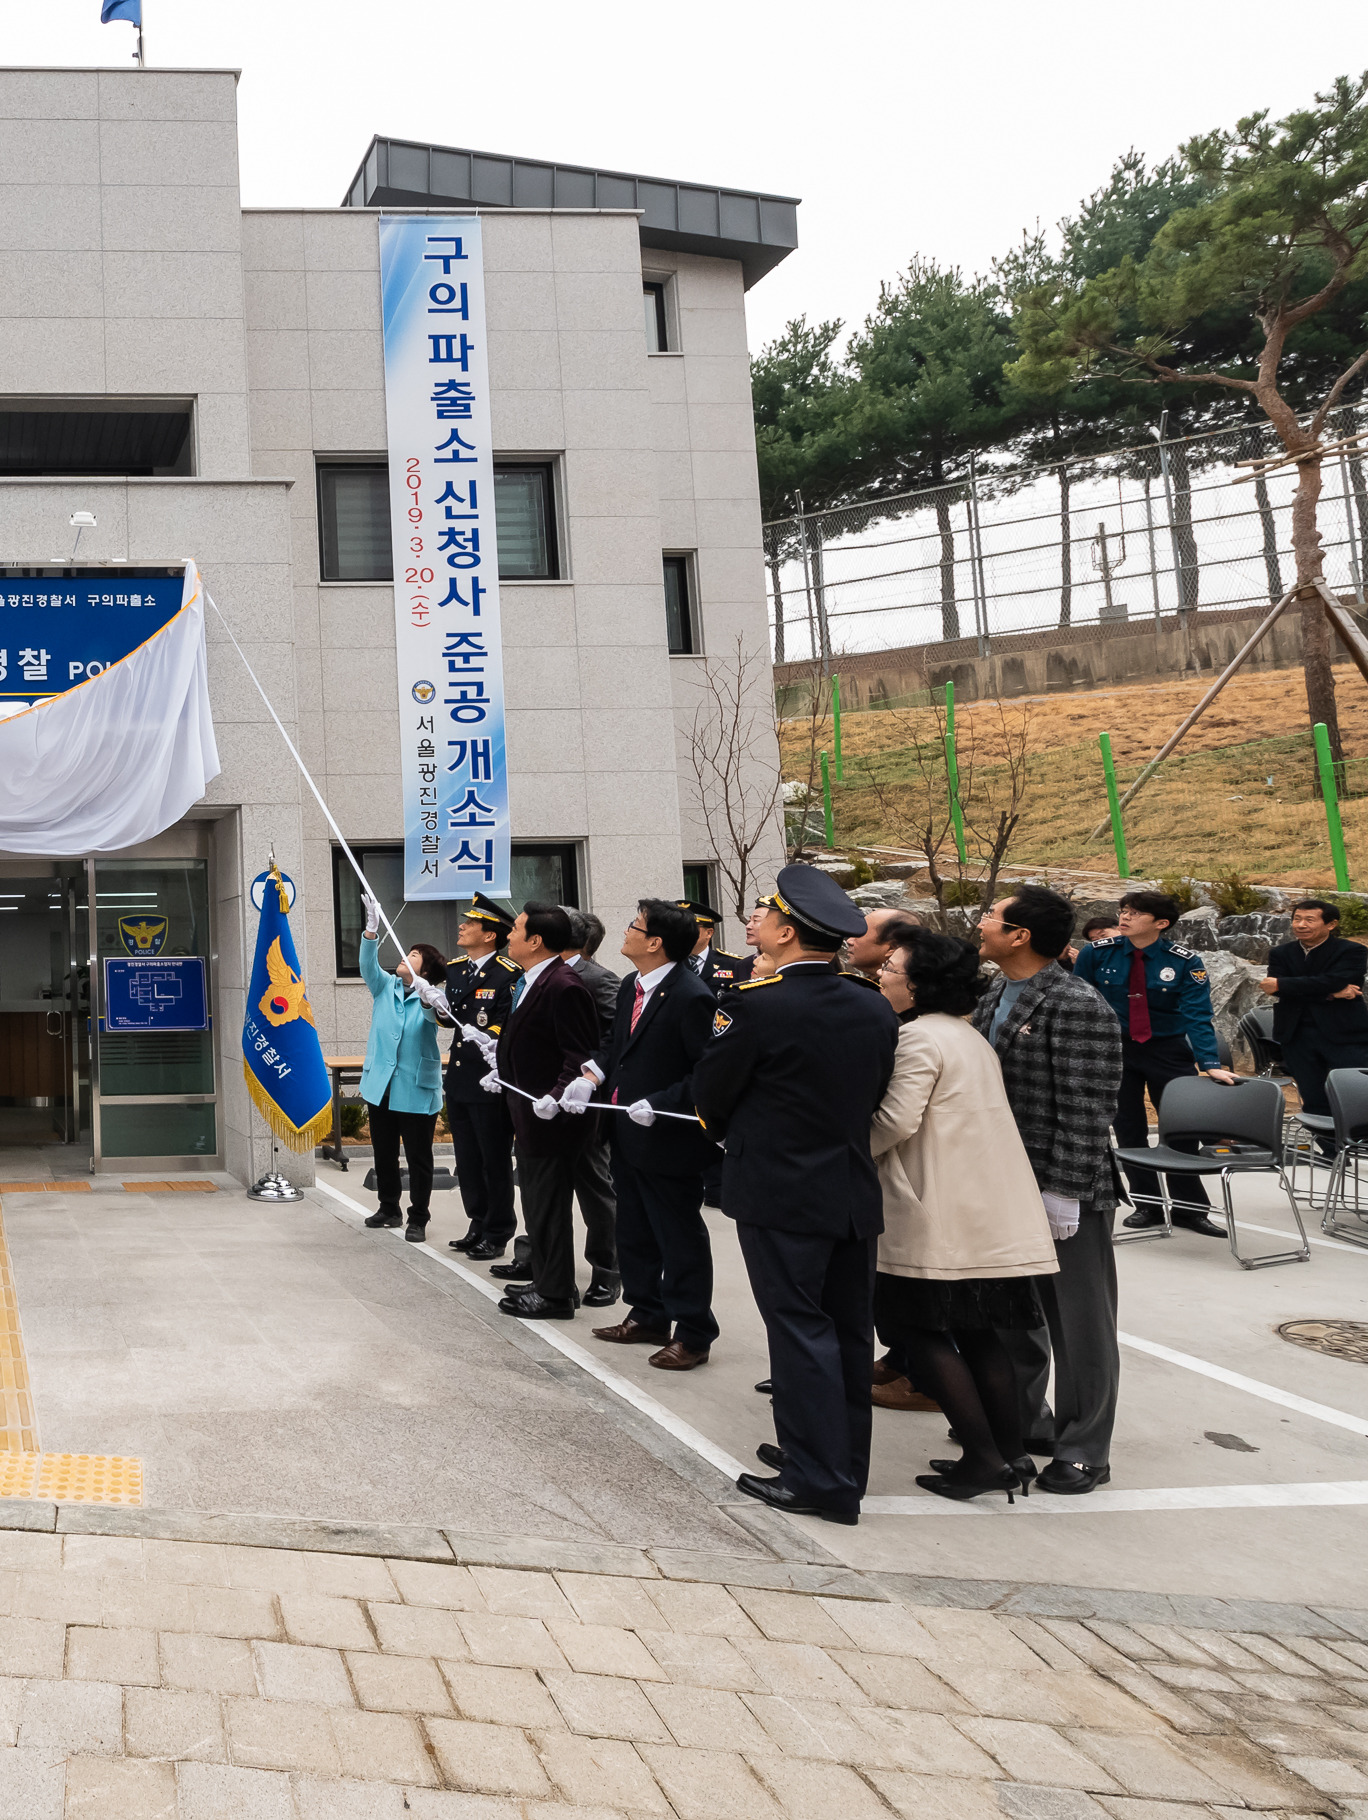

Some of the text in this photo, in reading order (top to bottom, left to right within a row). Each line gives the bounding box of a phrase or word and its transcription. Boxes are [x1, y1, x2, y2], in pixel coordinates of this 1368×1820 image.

[423, 235, 479, 465] 구의파출소
[87, 593, 157, 608] 구의파출소
[416, 715, 441, 878] 서울광진경찰서
